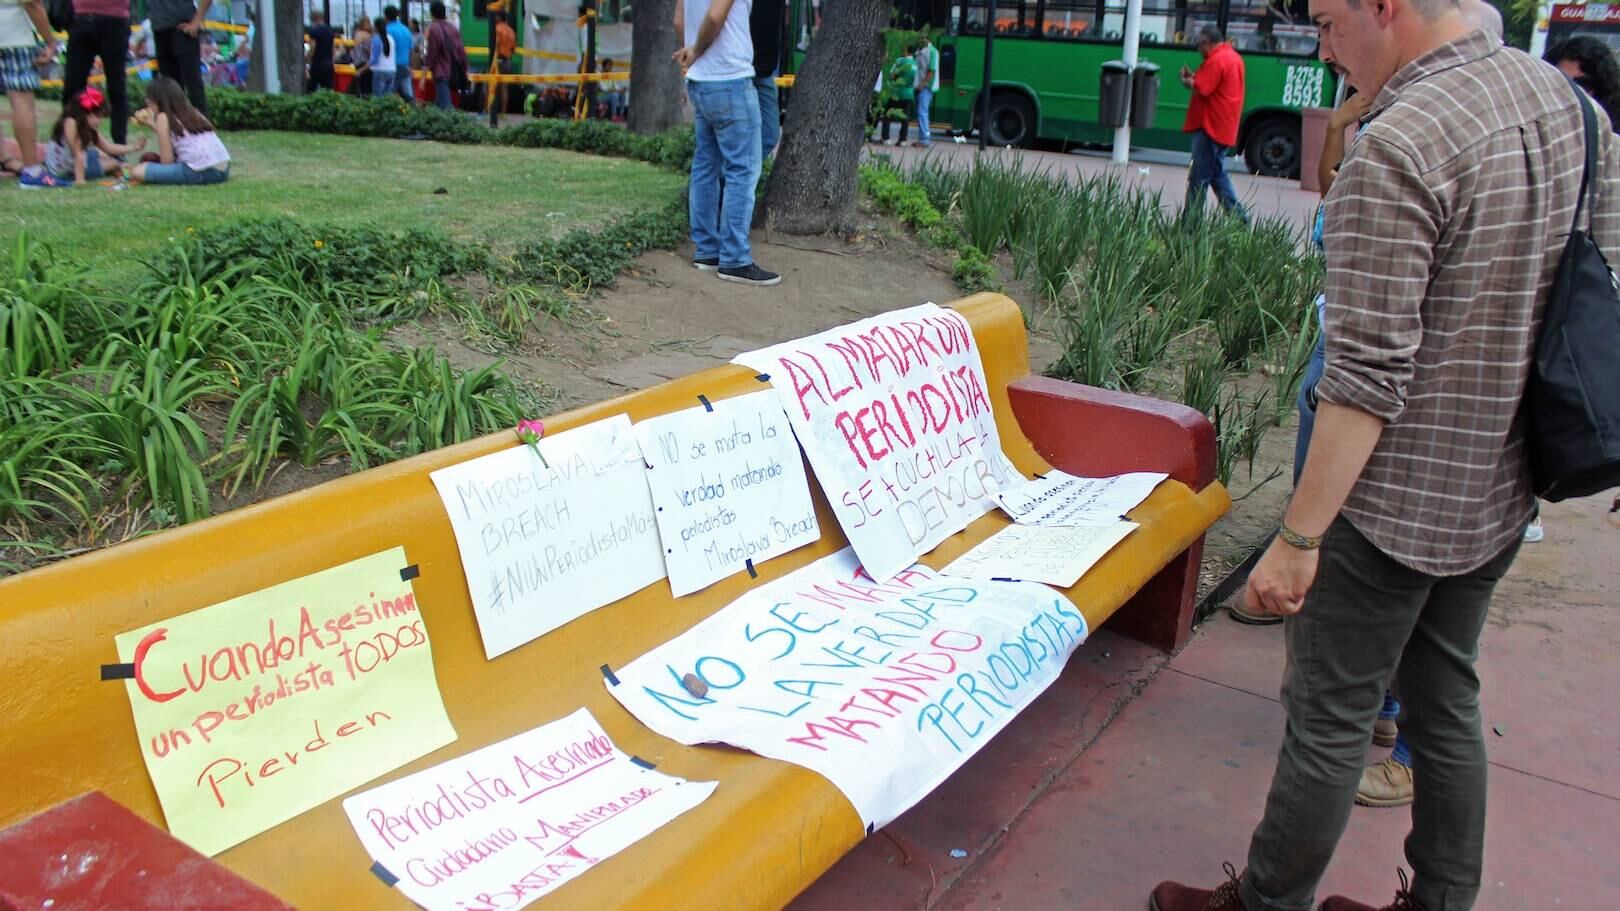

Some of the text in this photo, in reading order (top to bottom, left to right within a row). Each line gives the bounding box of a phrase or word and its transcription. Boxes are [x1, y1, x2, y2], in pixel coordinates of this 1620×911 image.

[1282, 84, 1322, 108] 8593
[778, 350, 854, 421] AL
[922, 313, 970, 356] UN
[658, 431, 679, 464] NO
[691, 441, 707, 460] se
[715, 418, 751, 453] mata
[759, 412, 777, 440] la
[835, 365, 990, 471] PERIODISTA
[675, 456, 782, 507] verdad matando
[842, 479, 882, 528] SE
[481, 499, 571, 557] BREACH
[681, 506, 737, 552] periodistas
[704, 531, 770, 571] Miroslava
[134, 618, 295, 703] Cuando
[642, 656, 746, 720] NO
[745, 602, 839, 661] SE
[736, 587, 977, 718] LA VERDAD
[786, 630, 983, 751] MATANDO
[917, 599, 1084, 752] PERIODISTAS
[151, 728, 192, 758] un
[192, 661, 334, 743] periodista
[197, 710, 391, 808] Pierden
[366, 770, 516, 850] Periodista
[405, 827, 518, 887] Ciudadano
